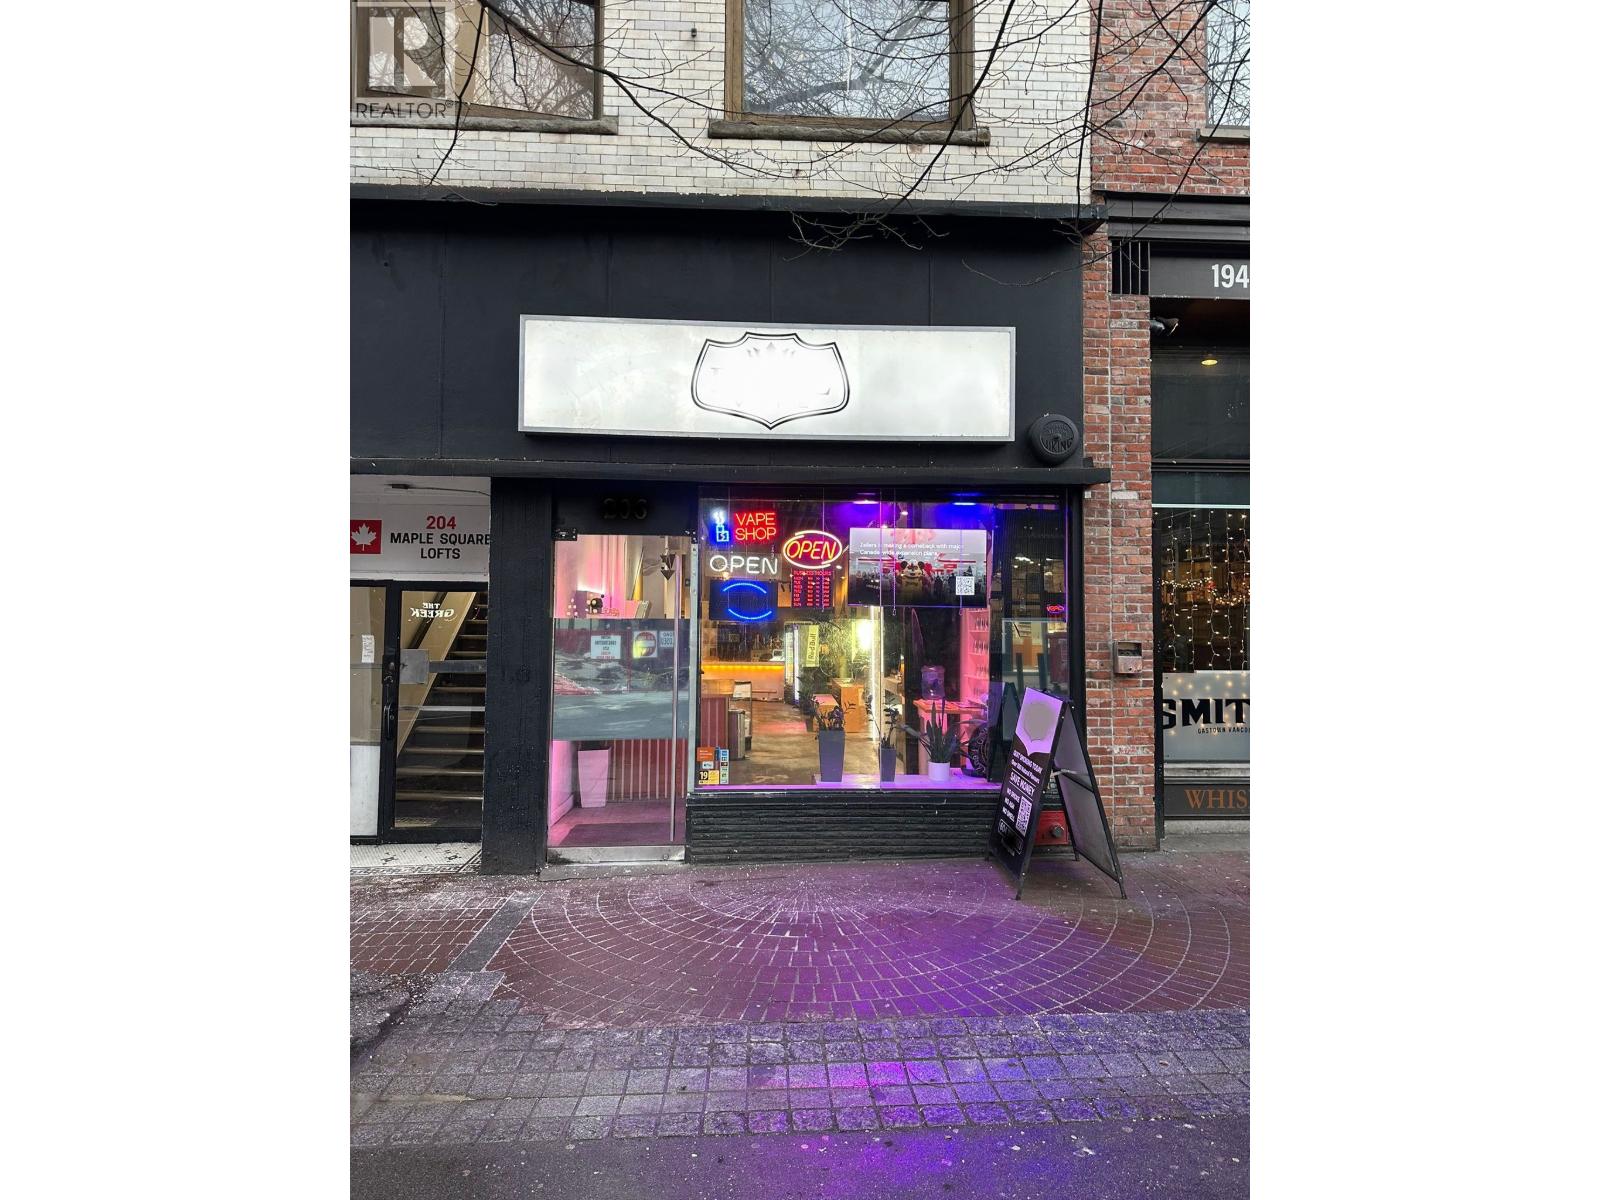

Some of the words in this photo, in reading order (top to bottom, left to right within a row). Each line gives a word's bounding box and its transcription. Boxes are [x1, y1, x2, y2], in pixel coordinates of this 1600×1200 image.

[1211, 264, 1250, 288] 194
[426, 515, 457, 530] 204
[735, 512, 776, 526] VAPE
[390, 532, 434, 544] MAPLE
[440, 533, 491, 546] SQUARE
[735, 527, 777, 541] SHOP
[420, 547, 461, 560] LOFTS
[786, 540, 837, 560] OPEN
[709, 555, 778, 575] OPEN
[1197, 726, 1226, 734] GASTOWN
[1010, 771, 1021, 786] SAVE
[1019, 778, 1035, 797] MONEY
[1184, 789, 1249, 810] WHIS
